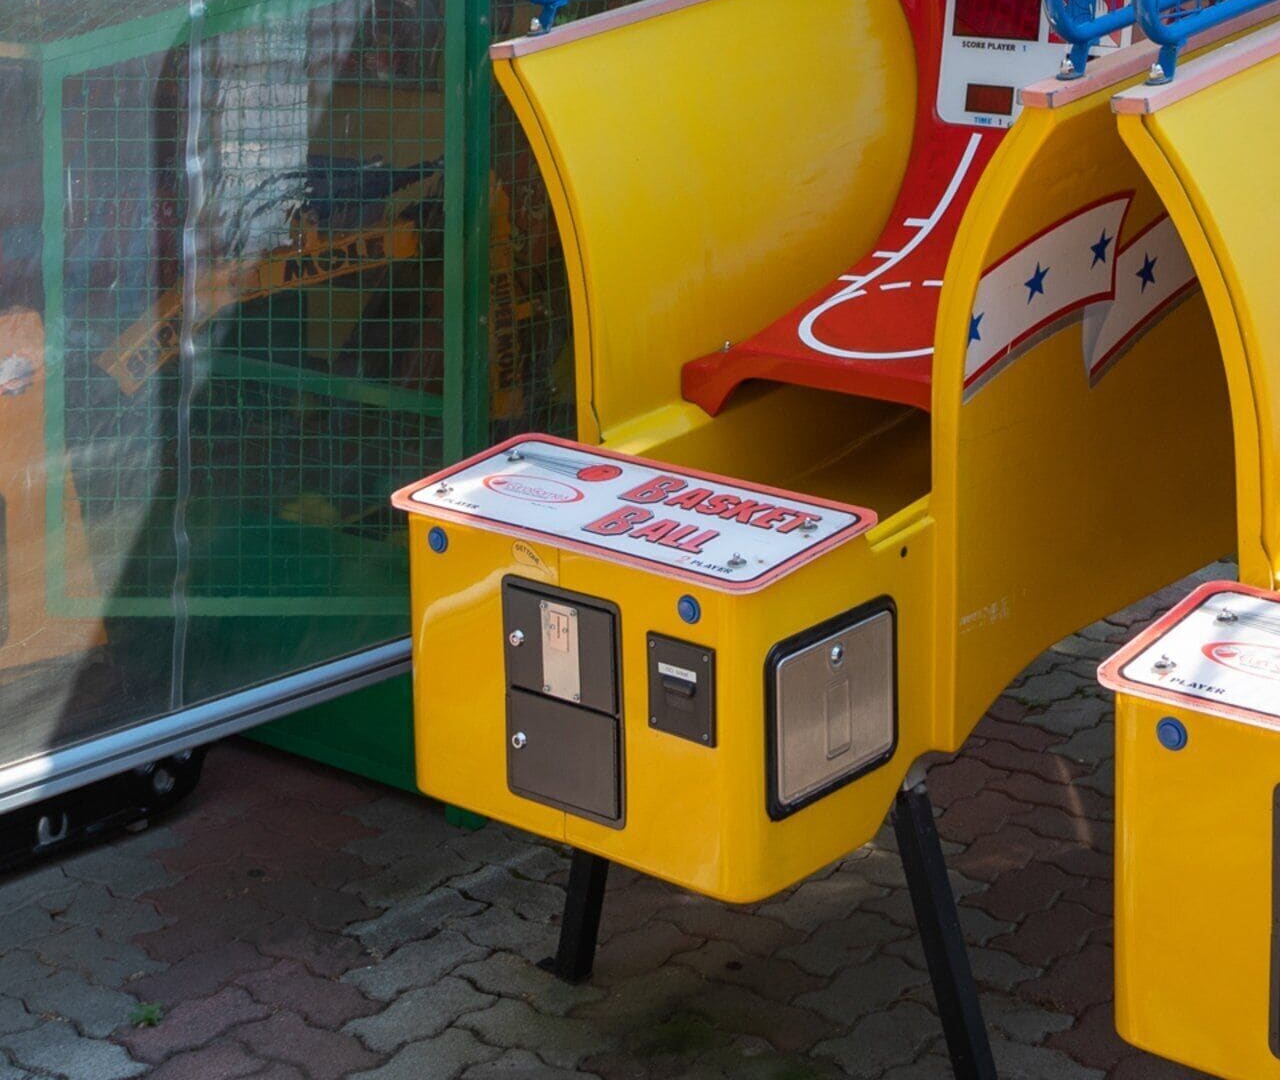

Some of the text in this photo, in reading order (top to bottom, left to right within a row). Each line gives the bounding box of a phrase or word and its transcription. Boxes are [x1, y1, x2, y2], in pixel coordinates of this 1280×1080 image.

[962, 40, 986, 50] SCORE
[987, 42, 1016, 52] PLAYER
[973, 116, 993, 125] TIME
[617, 474, 823, 534] BASKET
[580, 504, 721, 555] BALL
[690, 559, 734, 575] PLAYER
[1170, 677, 1227, 695] PLAYER
